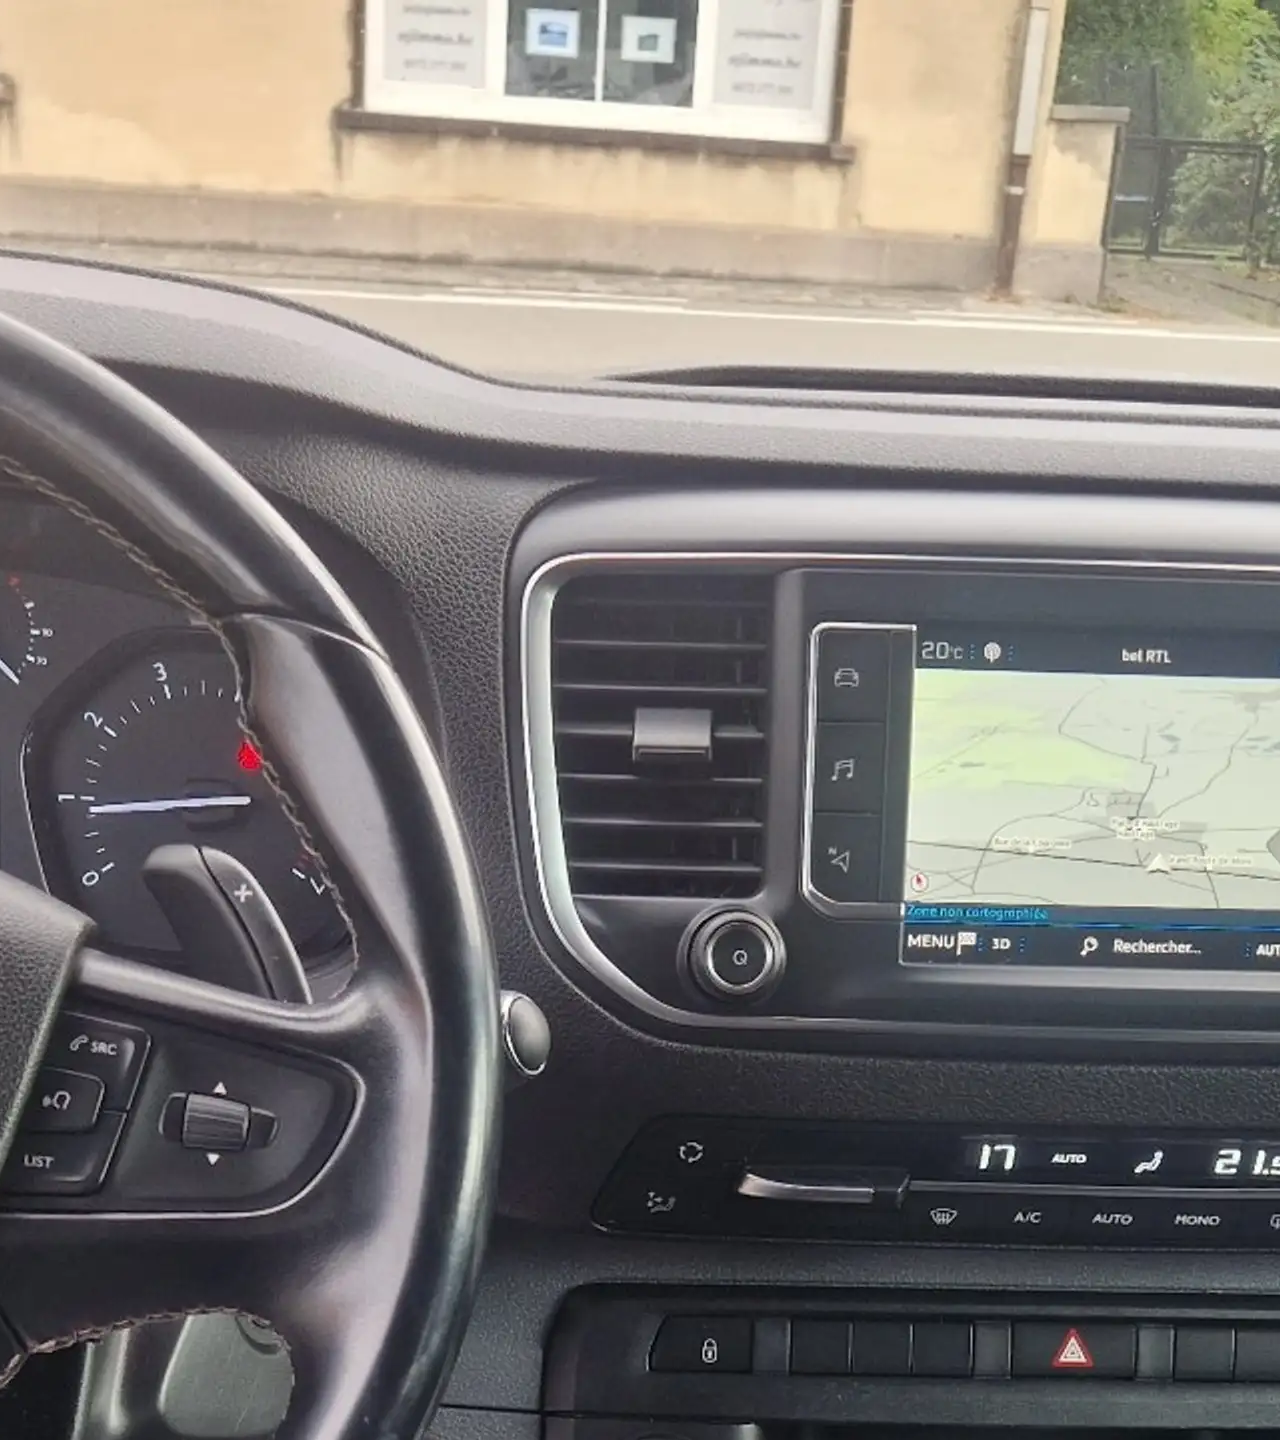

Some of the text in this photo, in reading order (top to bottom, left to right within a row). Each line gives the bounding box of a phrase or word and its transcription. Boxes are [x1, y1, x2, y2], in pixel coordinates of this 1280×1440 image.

[1145, 649, 1172, 663] RTL
[152, 662, 168, 682] 3
[83, 711, 104, 728] 2
[81, 871, 100, 887] 0
[907, 904, 938, 917] Zone
[940, 907, 964, 918] non
[908, 934, 955, 949] MENU
[992, 938, 1011, 950] 3D
[90, 1041, 118, 1055] SRC
[23, 1154, 55, 1169] LIST
[978, 1143, 1017, 1170] 17
[1051, 1153, 1087, 1165] AUTO
[1014, 1211, 1043, 1224] A/C
[1091, 1213, 1134, 1226] AUTO
[1174, 1214, 1222, 1227] MONO
